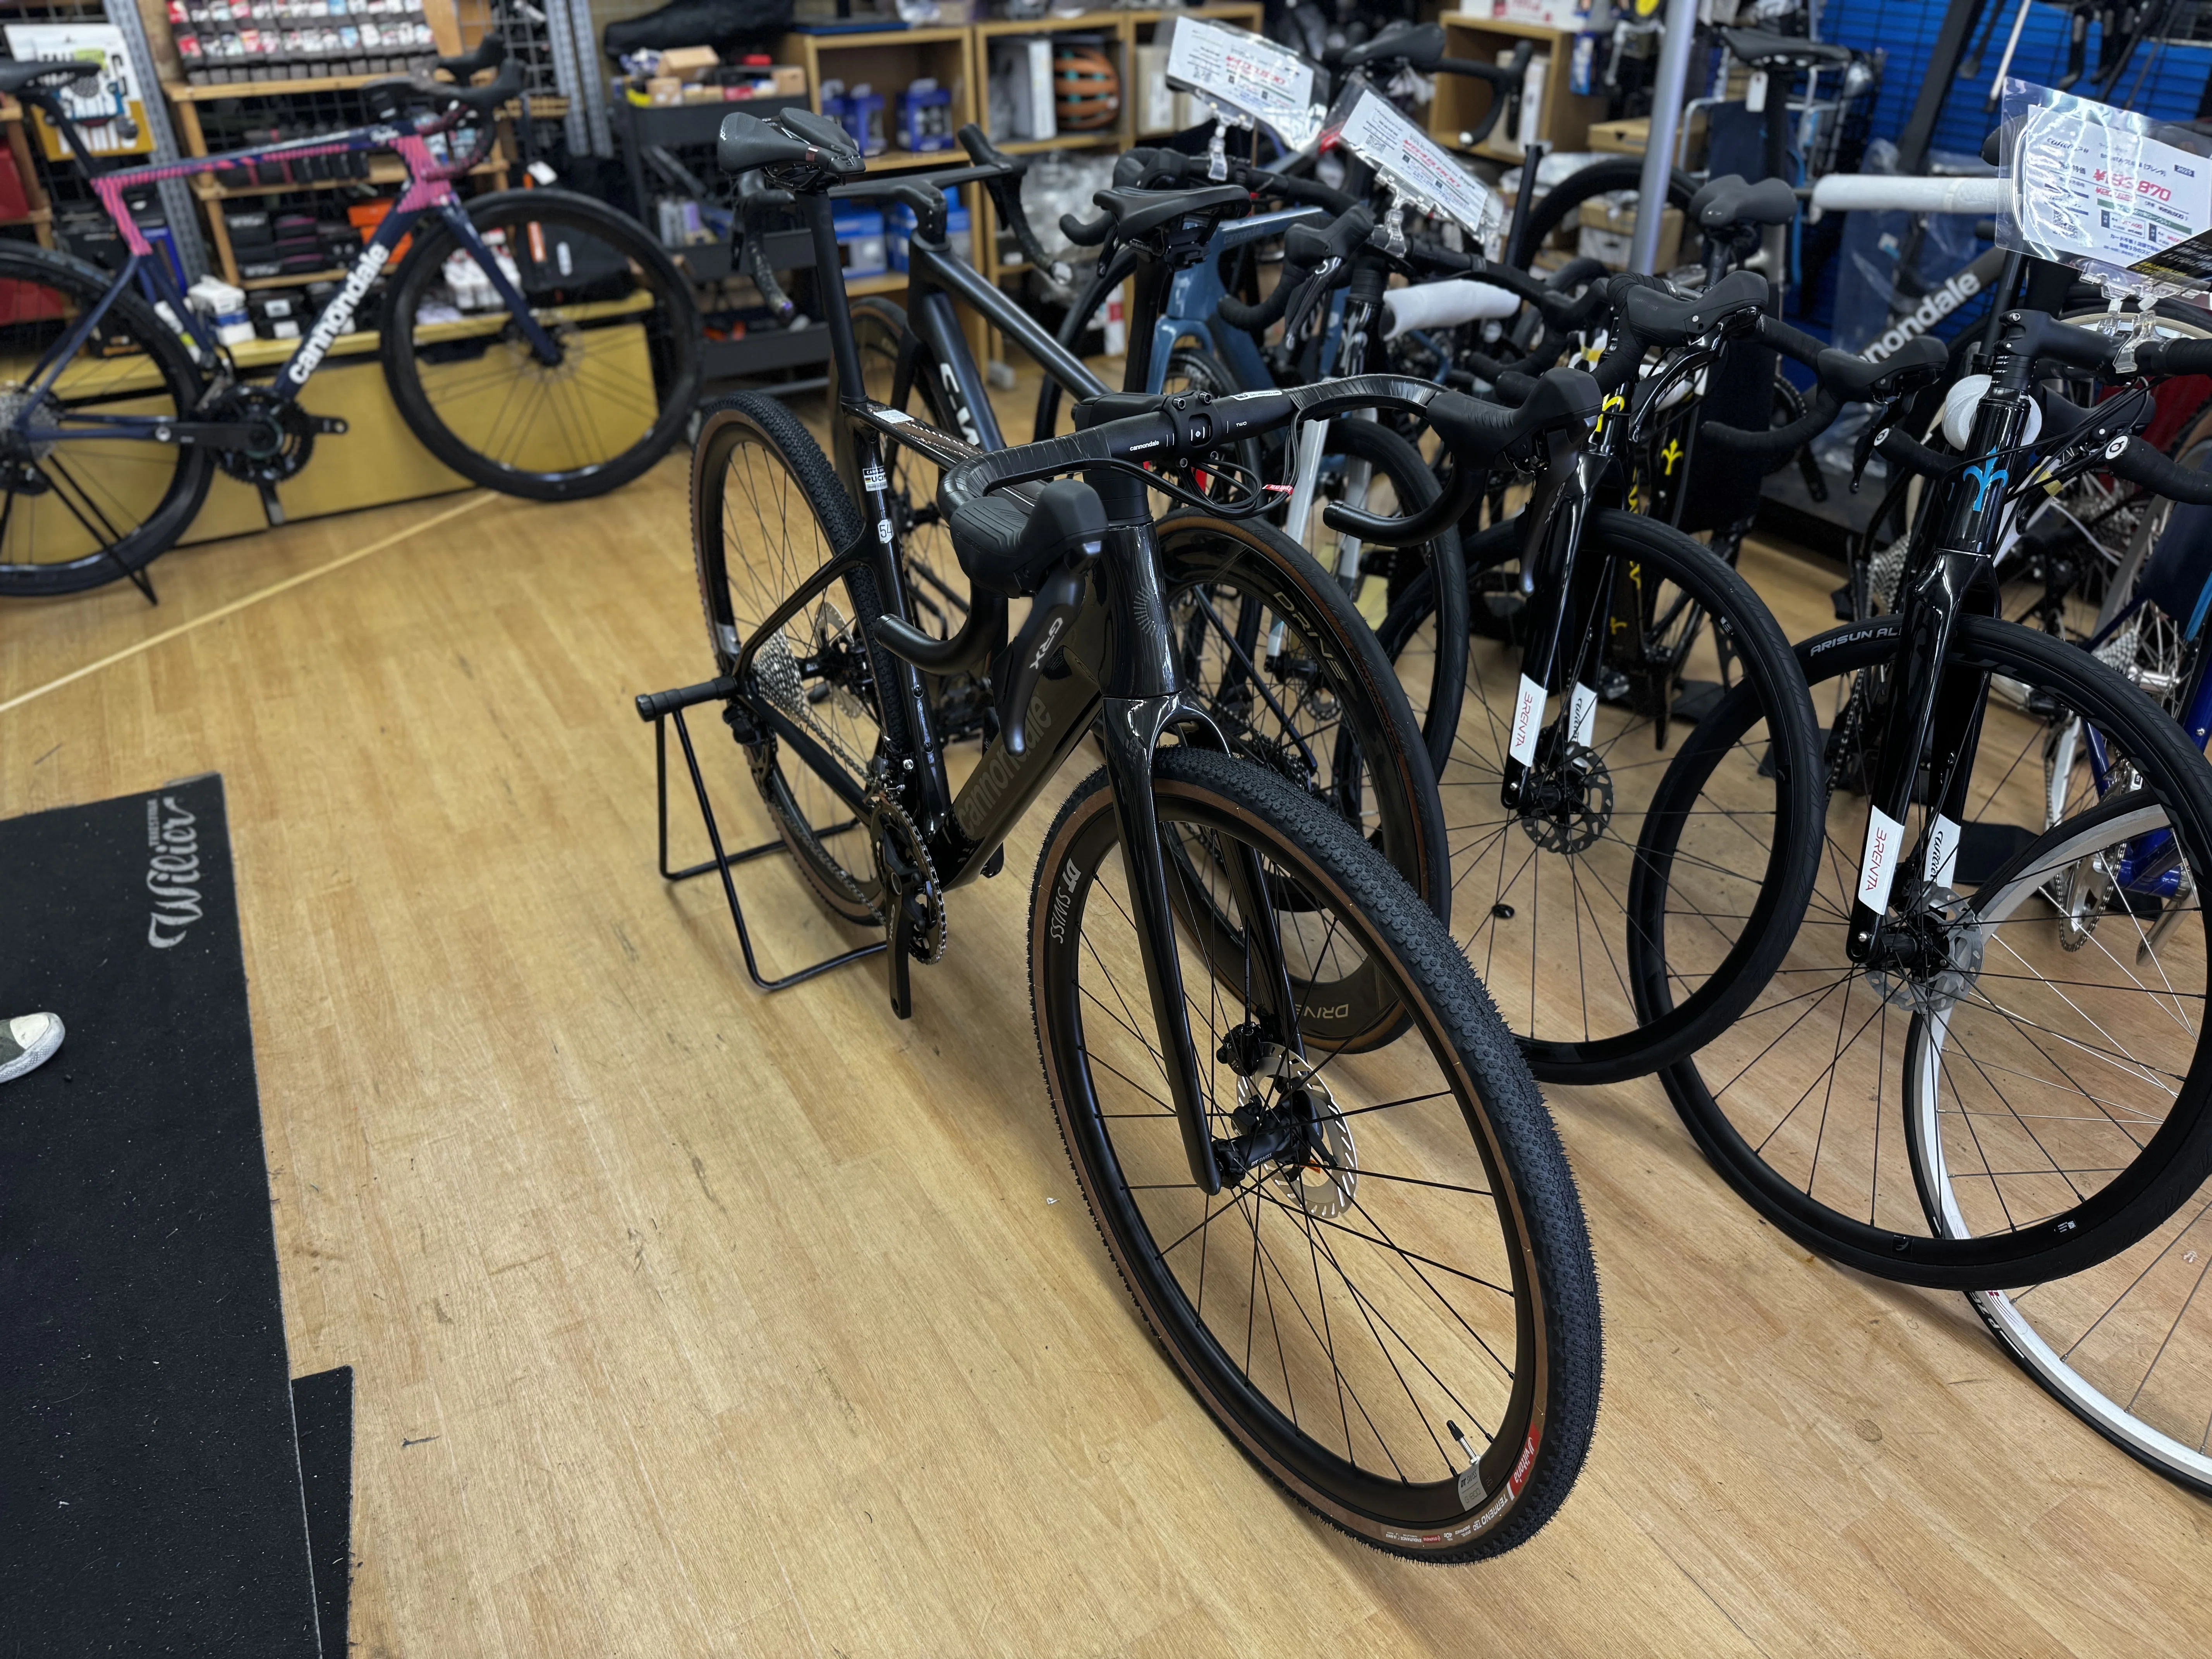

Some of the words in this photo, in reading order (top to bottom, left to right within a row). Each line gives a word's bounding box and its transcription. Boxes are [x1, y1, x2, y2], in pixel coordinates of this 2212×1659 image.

[289, 240, 390, 385] cannondale
[1858, 269, 1981, 362] nondale
[1130, 440, 1159, 451] cannondale
[1545, 482, 1565, 524] GRX
[879, 524, 893, 538] 54
[1029, 617, 1063, 669] GRX
[1273, 591, 1350, 682] DRIVE
[1810, 629, 1874, 657] ARISUN
[1877, 627, 1901, 638] AL
[1515, 692, 1533, 747] BRENTA
[147, 796, 204, 949] Wilier
[1062, 857, 1082, 893] DT
[1865, 827, 1886, 891] BRENTA
[1050, 886, 1072, 944] SWISS
[1259, 1152, 1272, 1163] SWISS
[1969, 1291, 1990, 1316] ZE
[1461, 1477, 1466, 1488] DT
[1467, 1470, 1477, 1484] SWISS
[1514, 1447, 1530, 1483] vittoria
[1481, 1494, 1508, 1525] TERRENO
